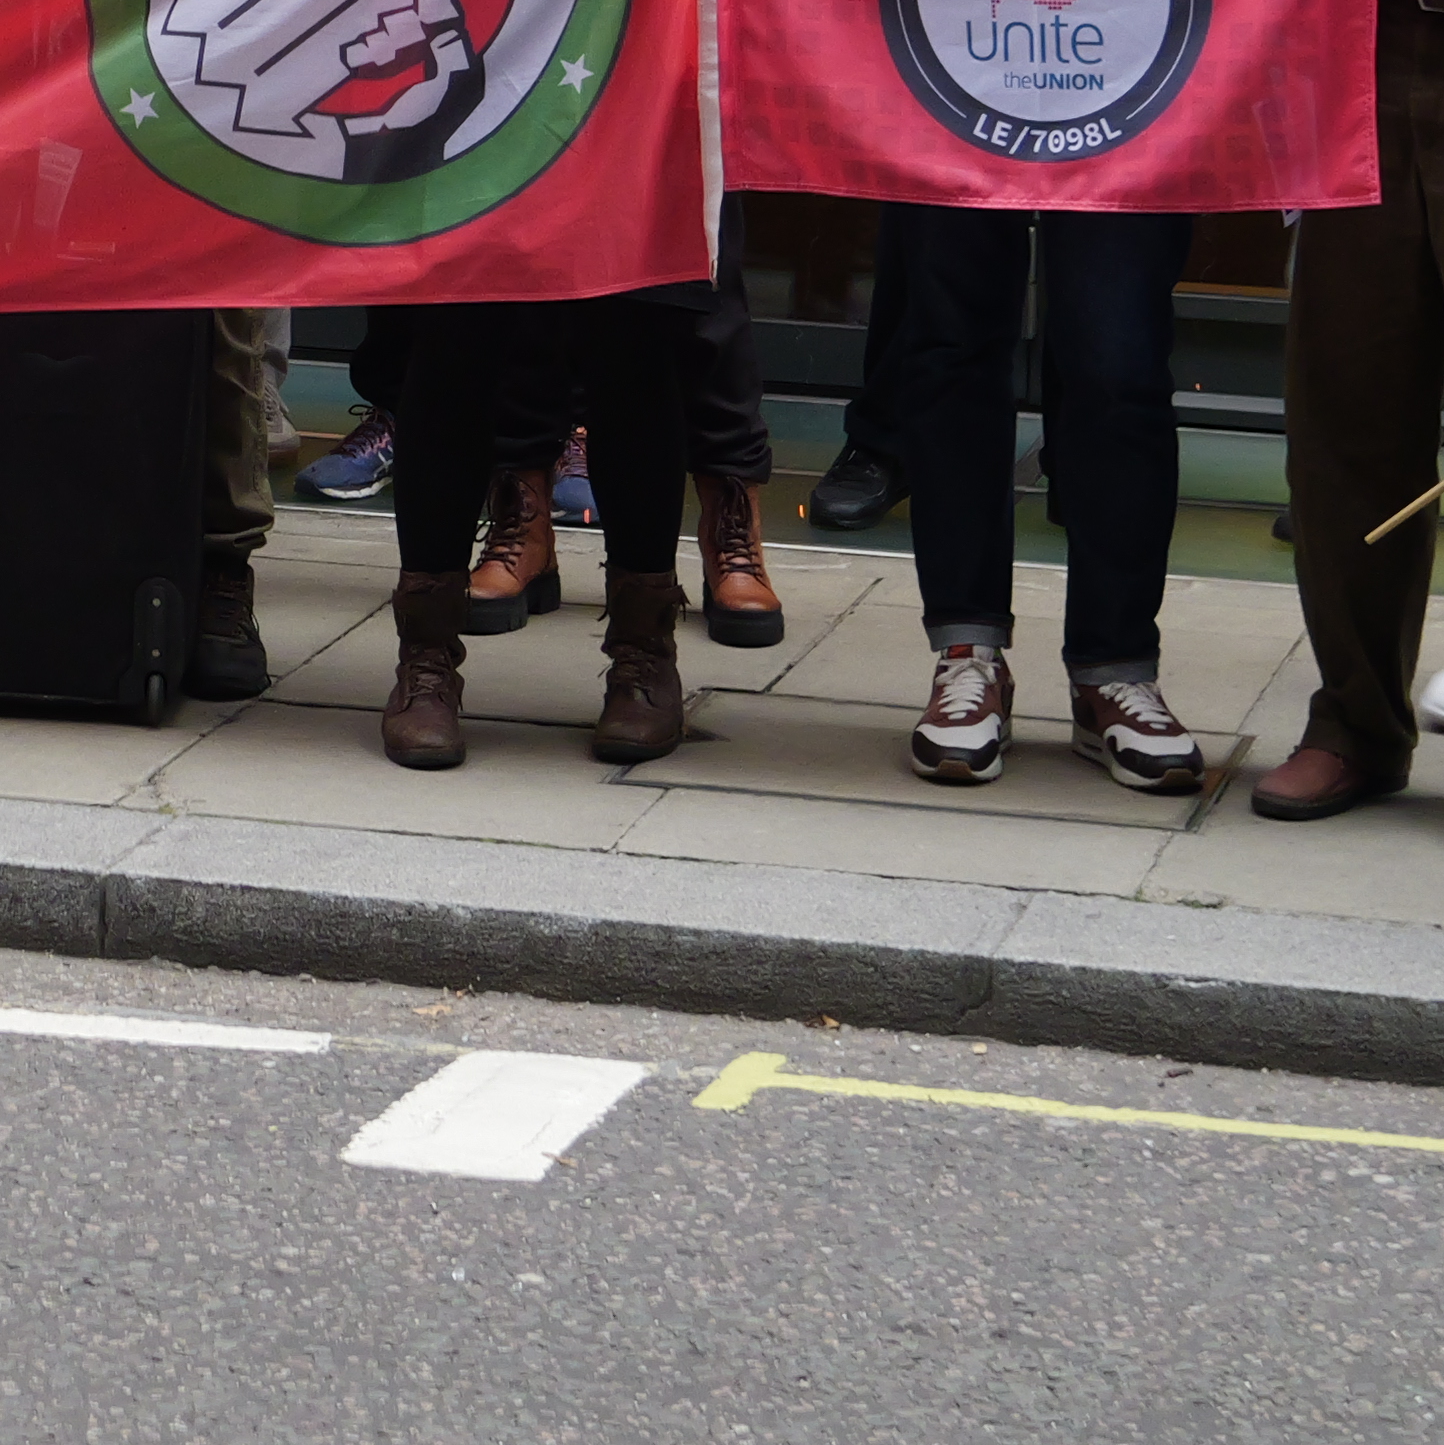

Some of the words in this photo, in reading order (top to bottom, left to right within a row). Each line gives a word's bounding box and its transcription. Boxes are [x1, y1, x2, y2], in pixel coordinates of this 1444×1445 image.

[965, 13, 1104, 65] unite
[1003, 71, 1104, 91] theUNION
[972, 112, 1123, 155] LE/7098L
